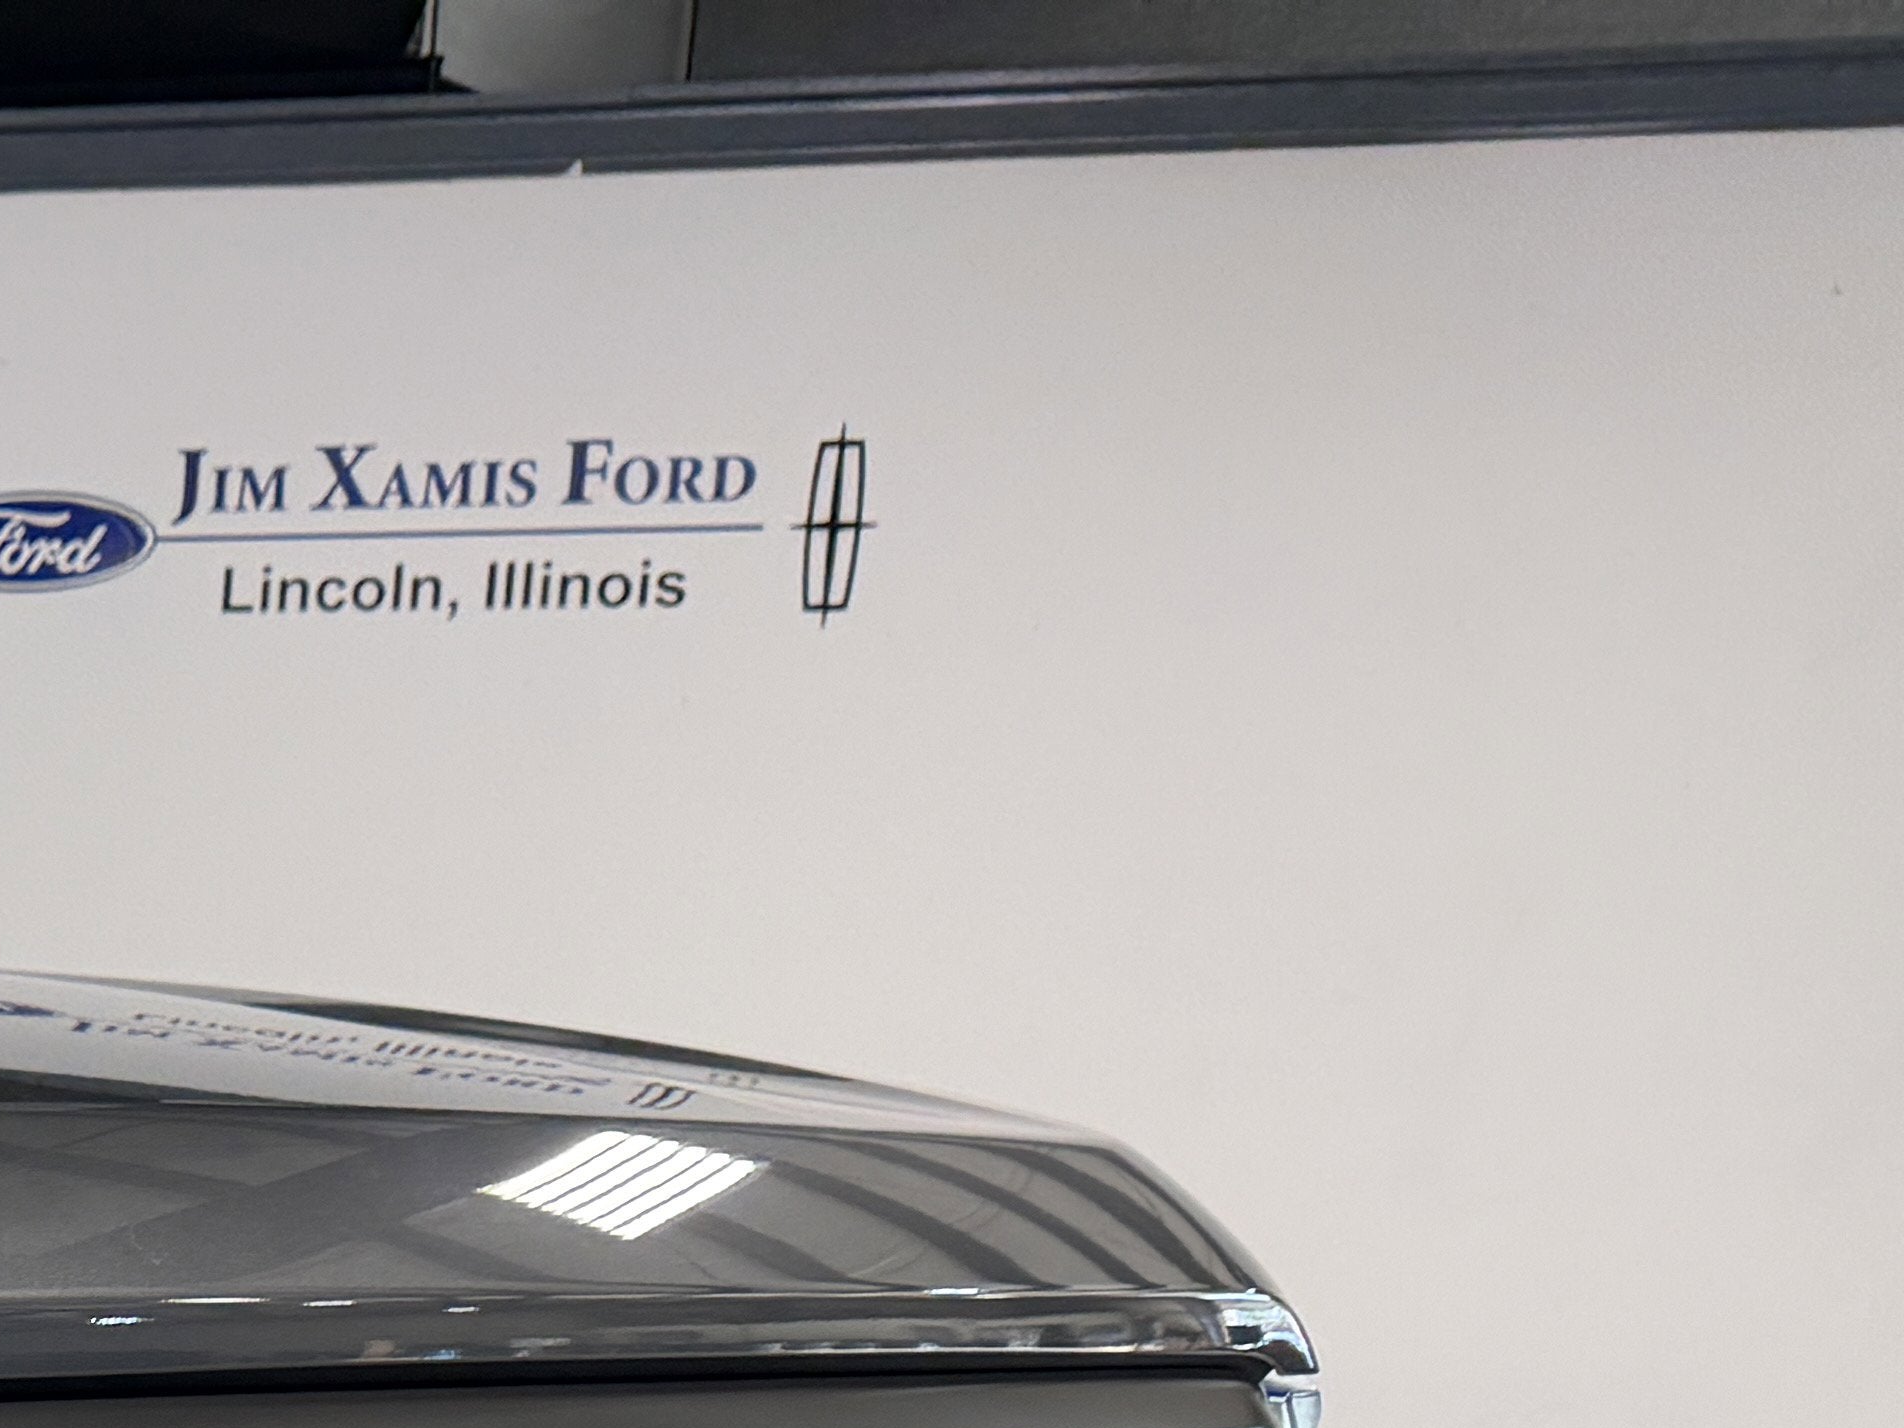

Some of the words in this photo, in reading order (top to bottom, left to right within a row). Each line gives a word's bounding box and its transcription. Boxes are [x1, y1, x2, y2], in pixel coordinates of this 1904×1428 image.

[171, 447, 289, 527] JIM
[309, 442, 538, 512] XAMIS
[560, 438, 758, 506] FORD
[221, 561, 460, 619] Lincoln,
[485, 557, 688, 610] Illinois
